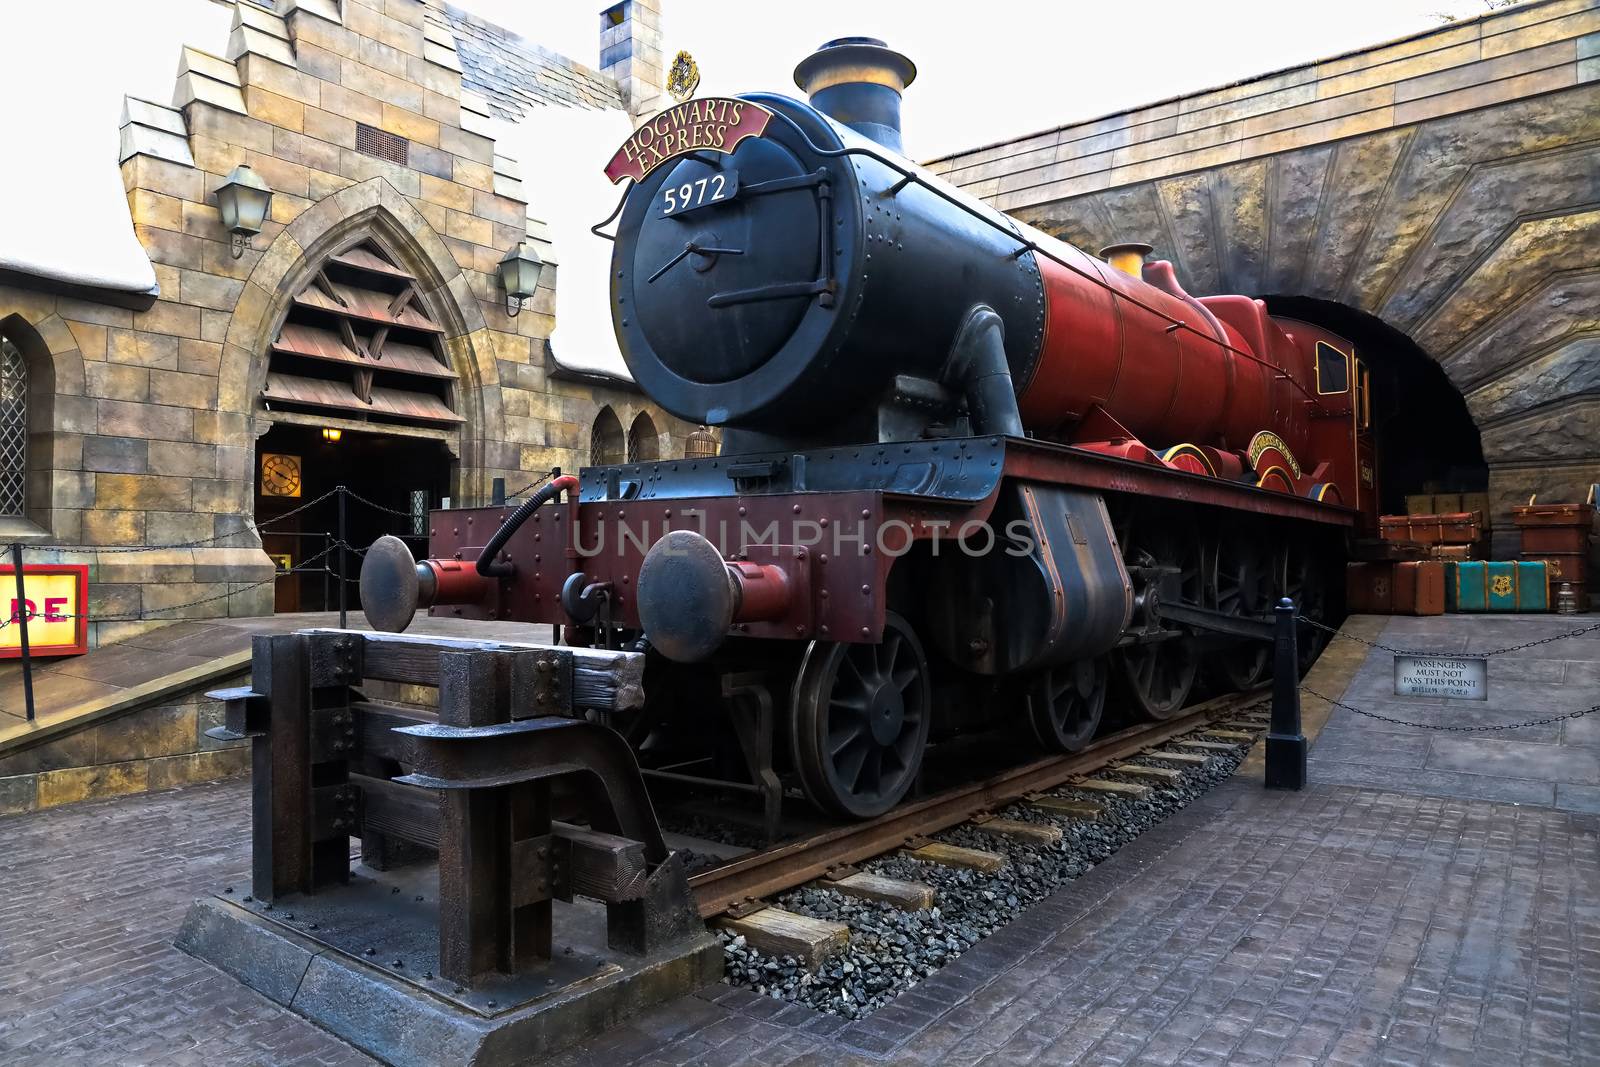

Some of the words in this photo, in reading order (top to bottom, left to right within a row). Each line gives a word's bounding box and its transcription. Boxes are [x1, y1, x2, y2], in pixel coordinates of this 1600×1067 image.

[623, 99, 744, 163] HOGWARTS
[637, 124, 728, 174] EXPRESS
[663, 174, 726, 214] 5972
[1413, 660, 1467, 669] PASSENGERS
[1416, 669, 1440, 677] MUST
[1443, 670, 1463, 678] NOT
[1403, 676, 1422, 685] PASS
[1424, 677, 1445, 686] THIS
[1447, 679, 1476, 688] POINT
